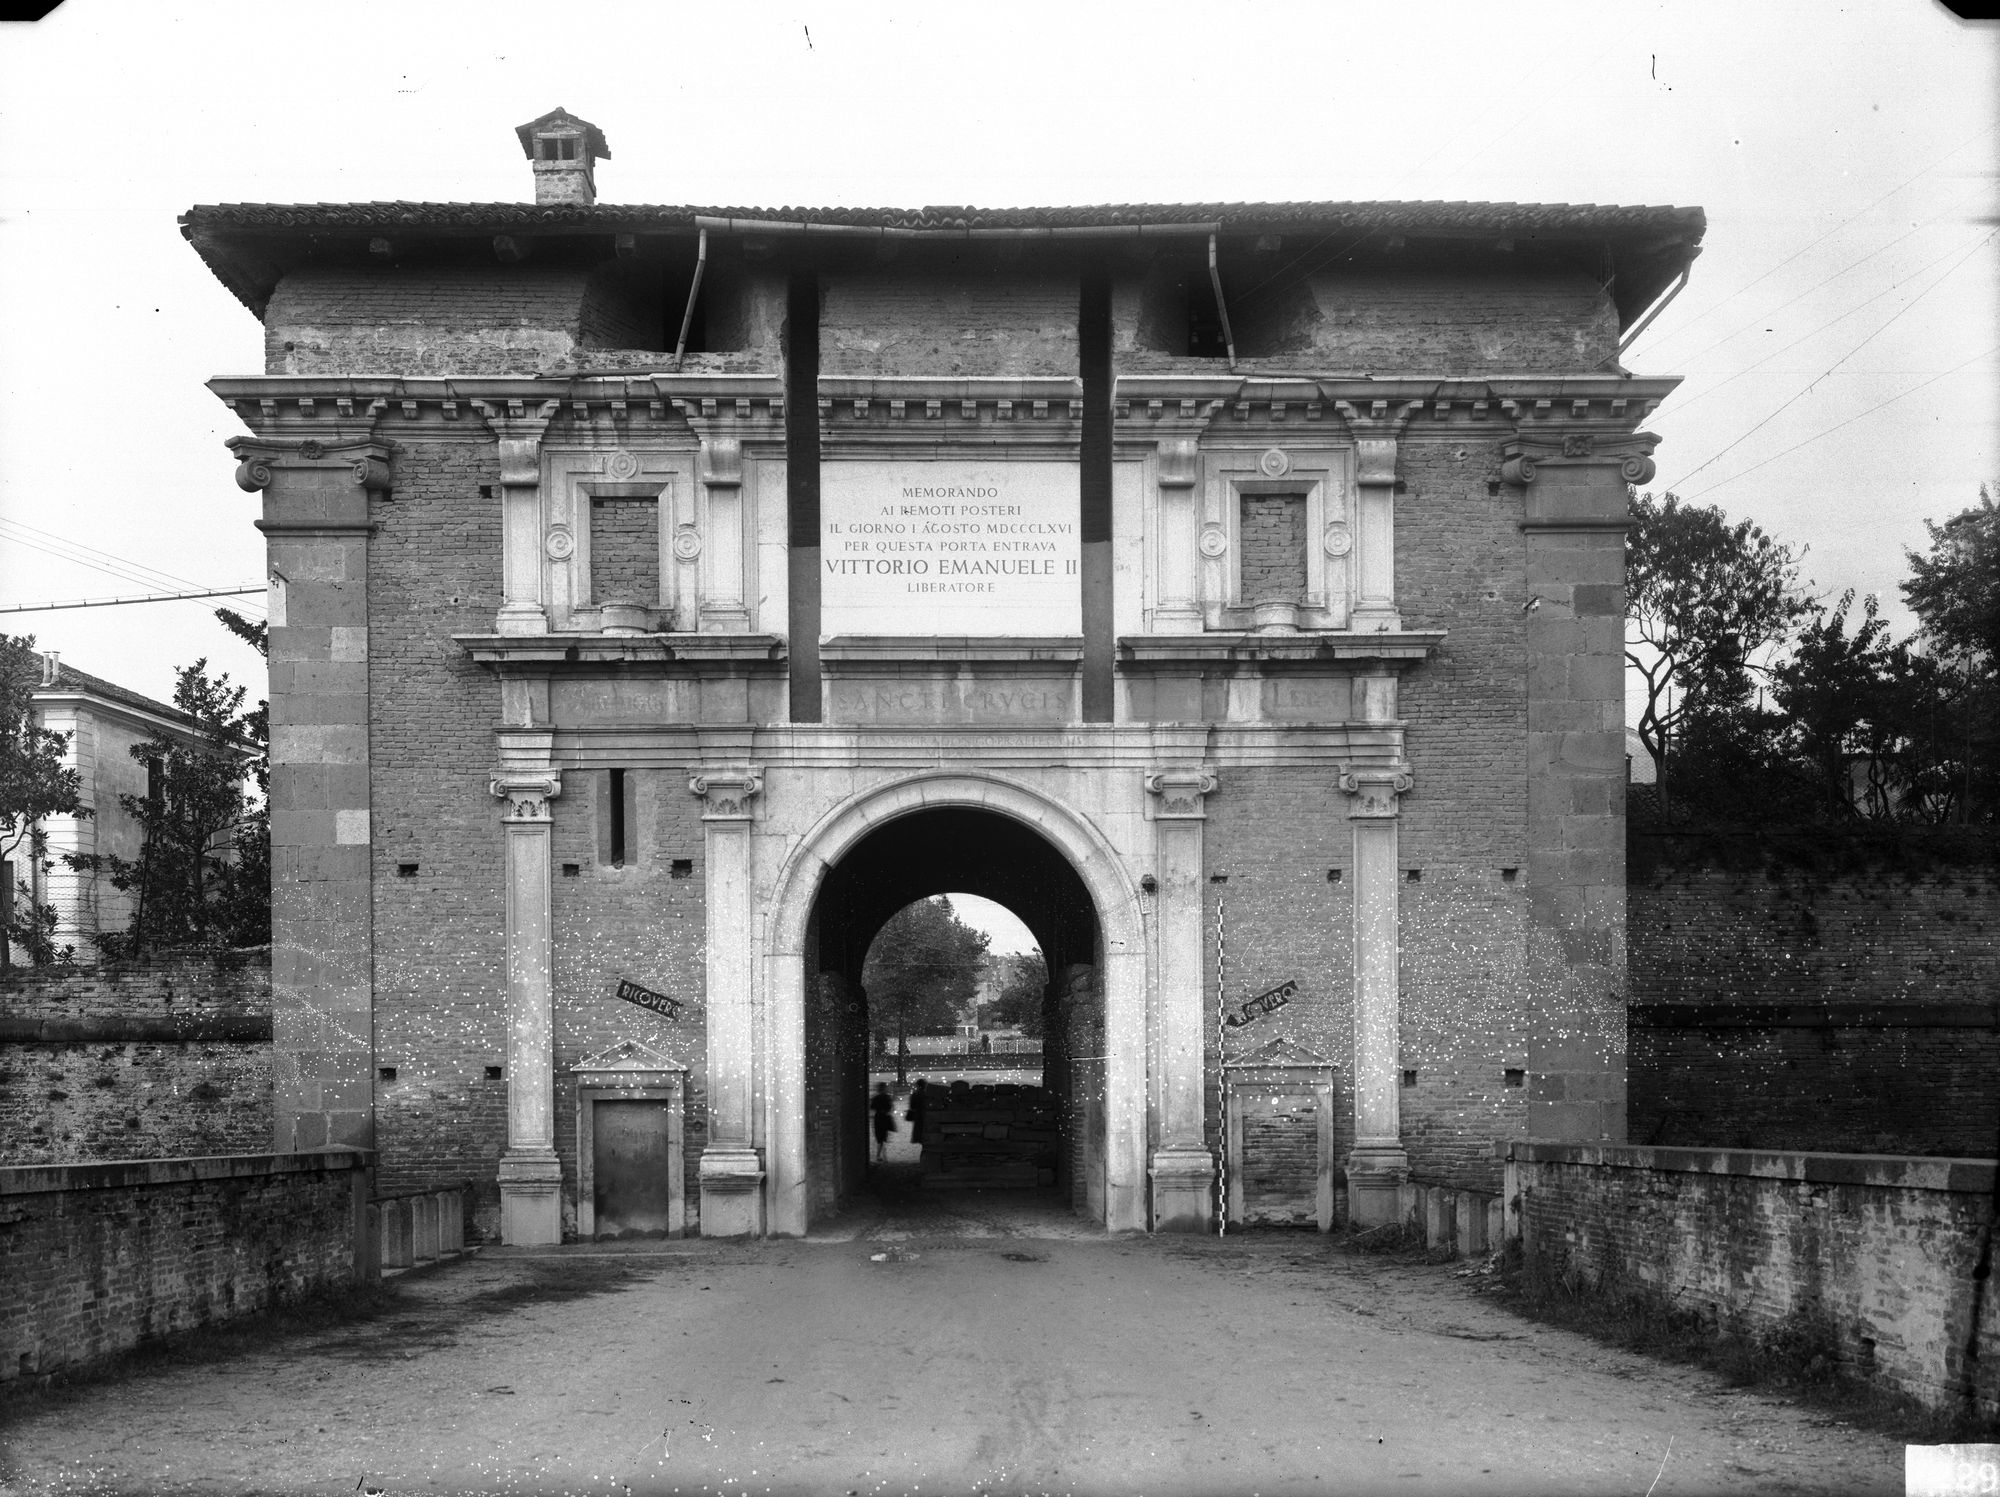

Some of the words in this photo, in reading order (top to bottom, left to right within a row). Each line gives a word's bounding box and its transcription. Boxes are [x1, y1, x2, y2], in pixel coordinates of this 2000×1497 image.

[902, 487, 998, 498] MEMORANDO
[881, 505, 894, 516] AI
[900, 505, 955, 516] REMOTI
[961, 505, 1021, 516] POSTERI
[830, 523, 842, 534] IL
[849, 523, 906, 534] GIORNO
[987, 523, 1072, 534] MDCCCLXVI
[844, 541, 869, 552] PER
[876, 541, 933, 553] QUESTA
[940, 541, 986, 552] PORTA
[993, 541, 1057, 552] ENTRAVA
[825, 559, 929, 575] VITTORIO
[939, 559, 1055, 575] EMANUELE
[1065, 559, 1078, 575] II
[907, 582, 995, 593] LIBERATORE
